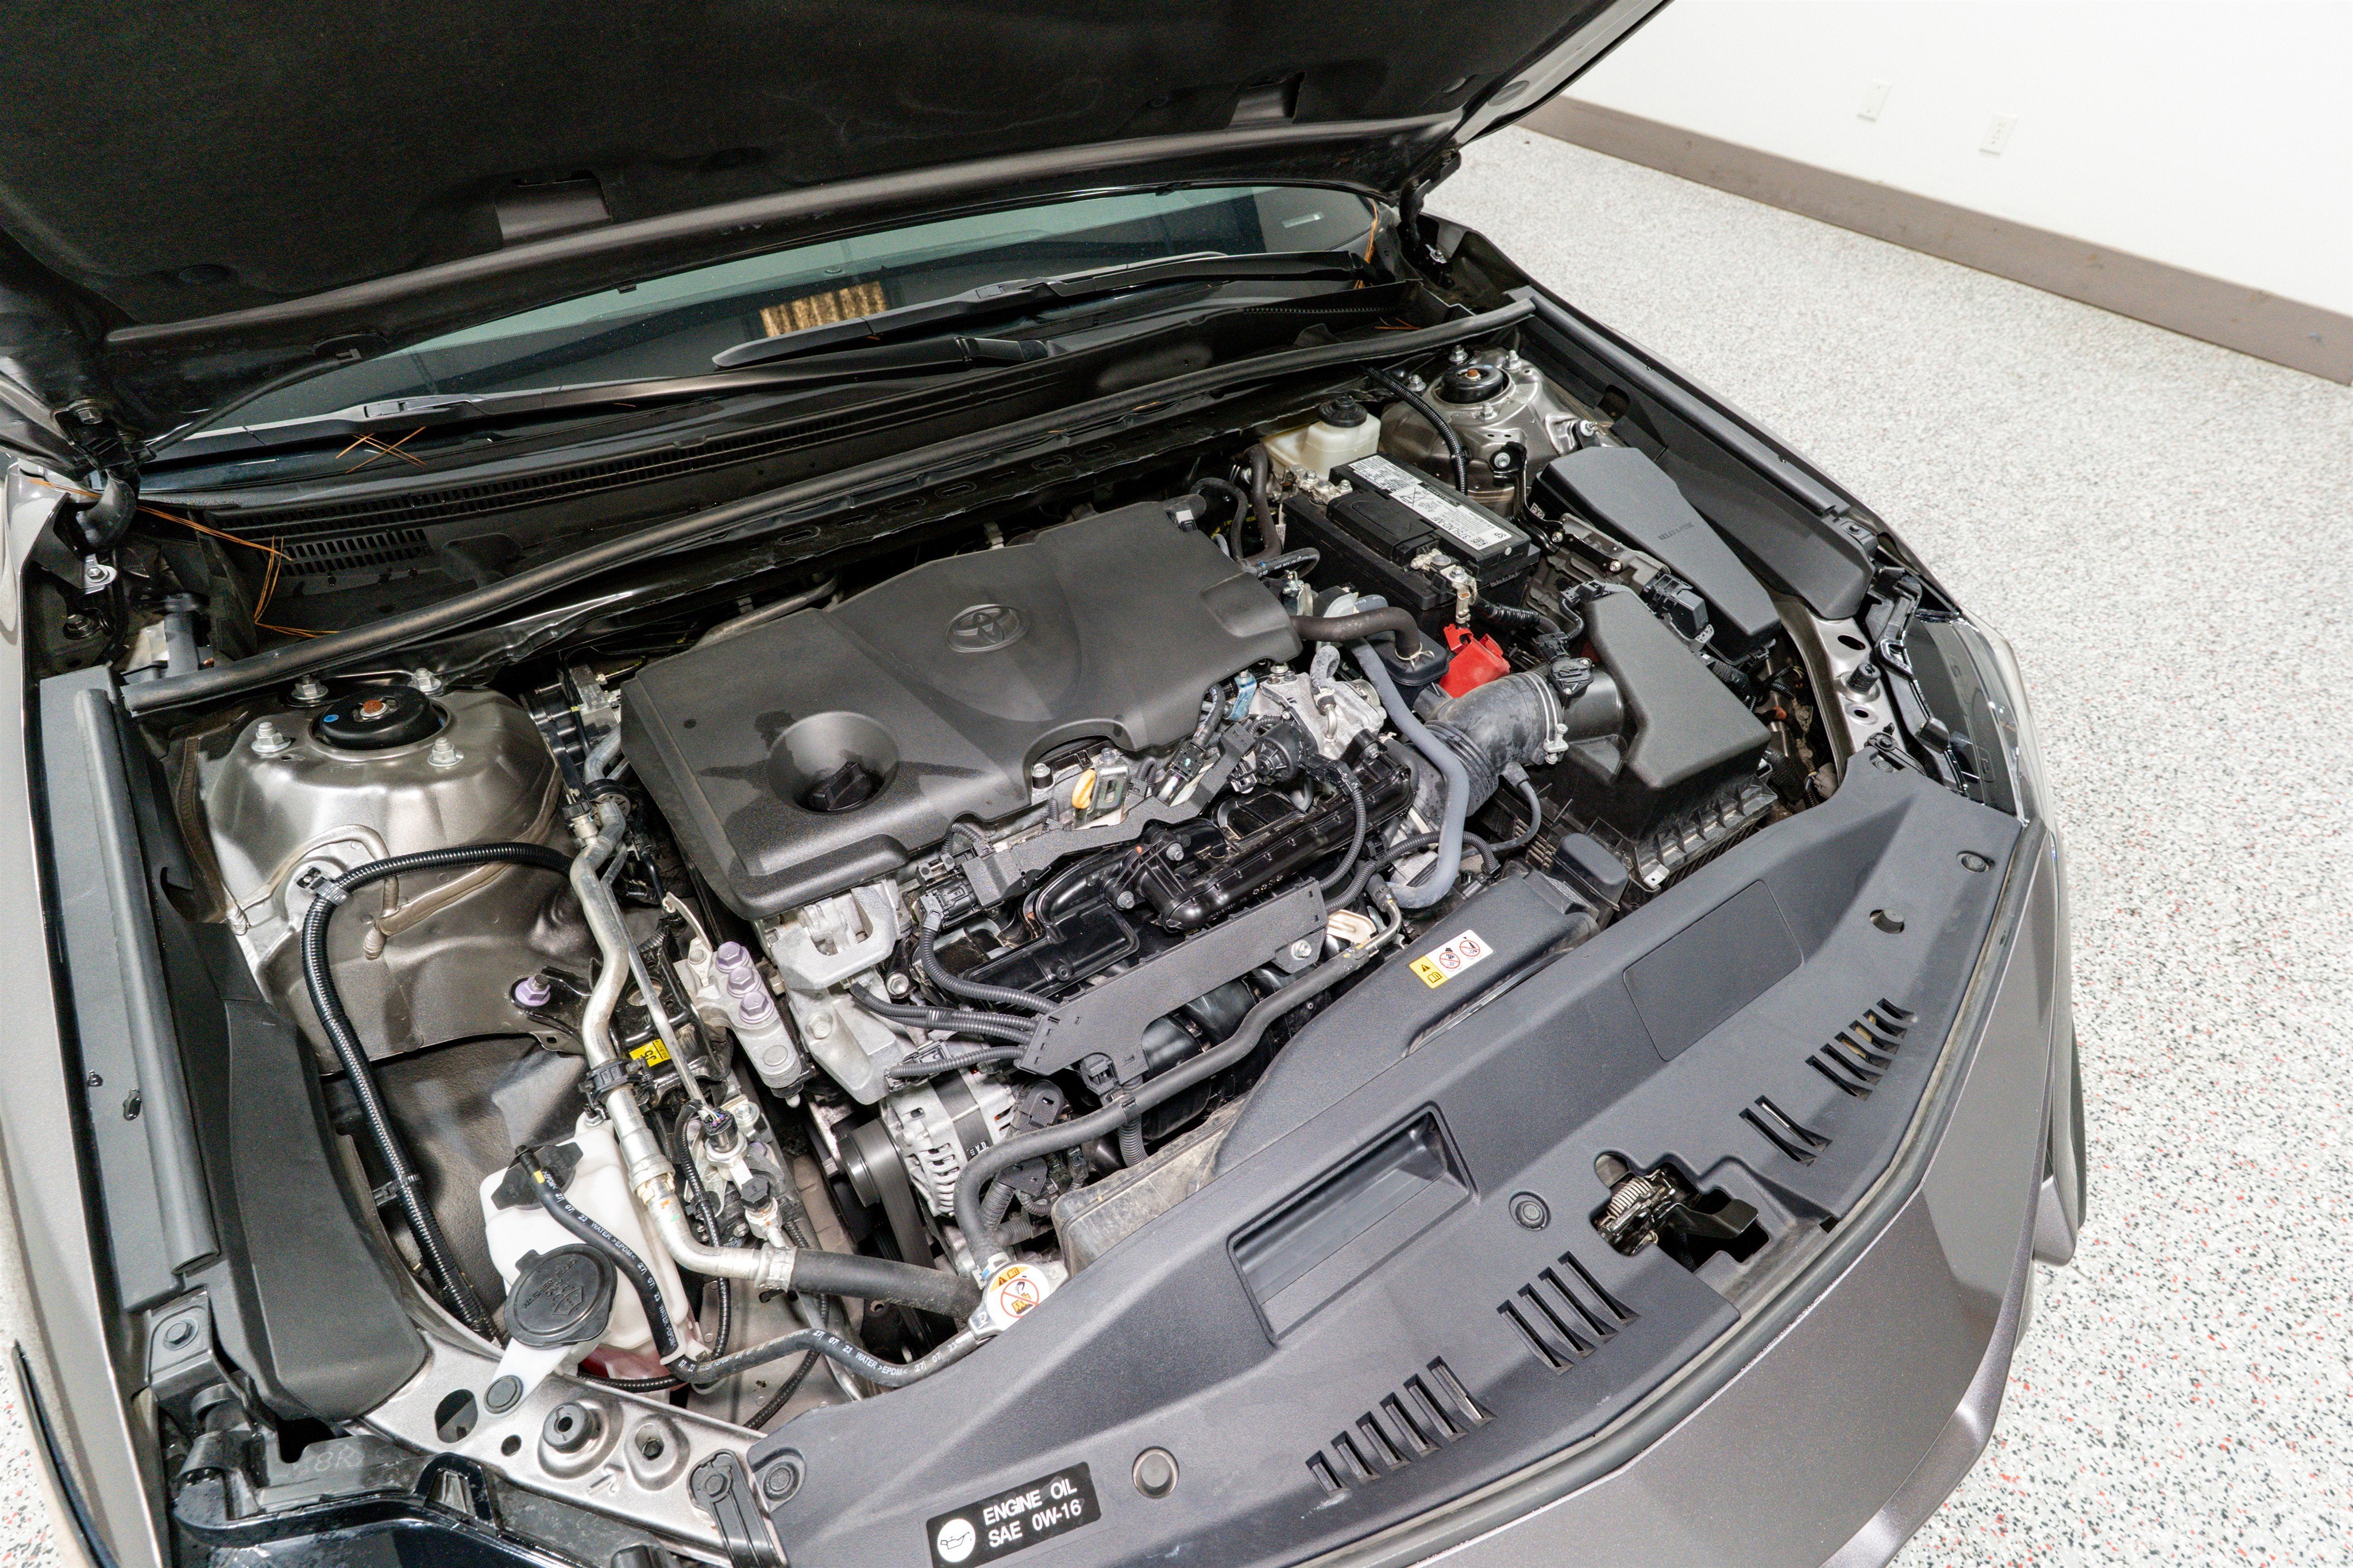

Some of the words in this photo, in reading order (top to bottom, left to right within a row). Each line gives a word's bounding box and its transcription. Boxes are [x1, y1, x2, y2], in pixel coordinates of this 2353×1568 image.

[1430, 516, 1471, 539] 375LN2-MF
[1658, 530, 1675, 540] RELAY
[590, 1222, 612, 1240] WATER
[658, 1303, 669, 1327] WATER
[522, 1279, 554, 1308] WASHER
[855, 1351, 878, 1370] WATER
[982, 1489, 1042, 1525] ENGINE
[1050, 1478, 1078, 1500] OIL
[988, 1521, 1023, 1548] SAE
[1032, 1500, 1081, 1530] 0W-16
